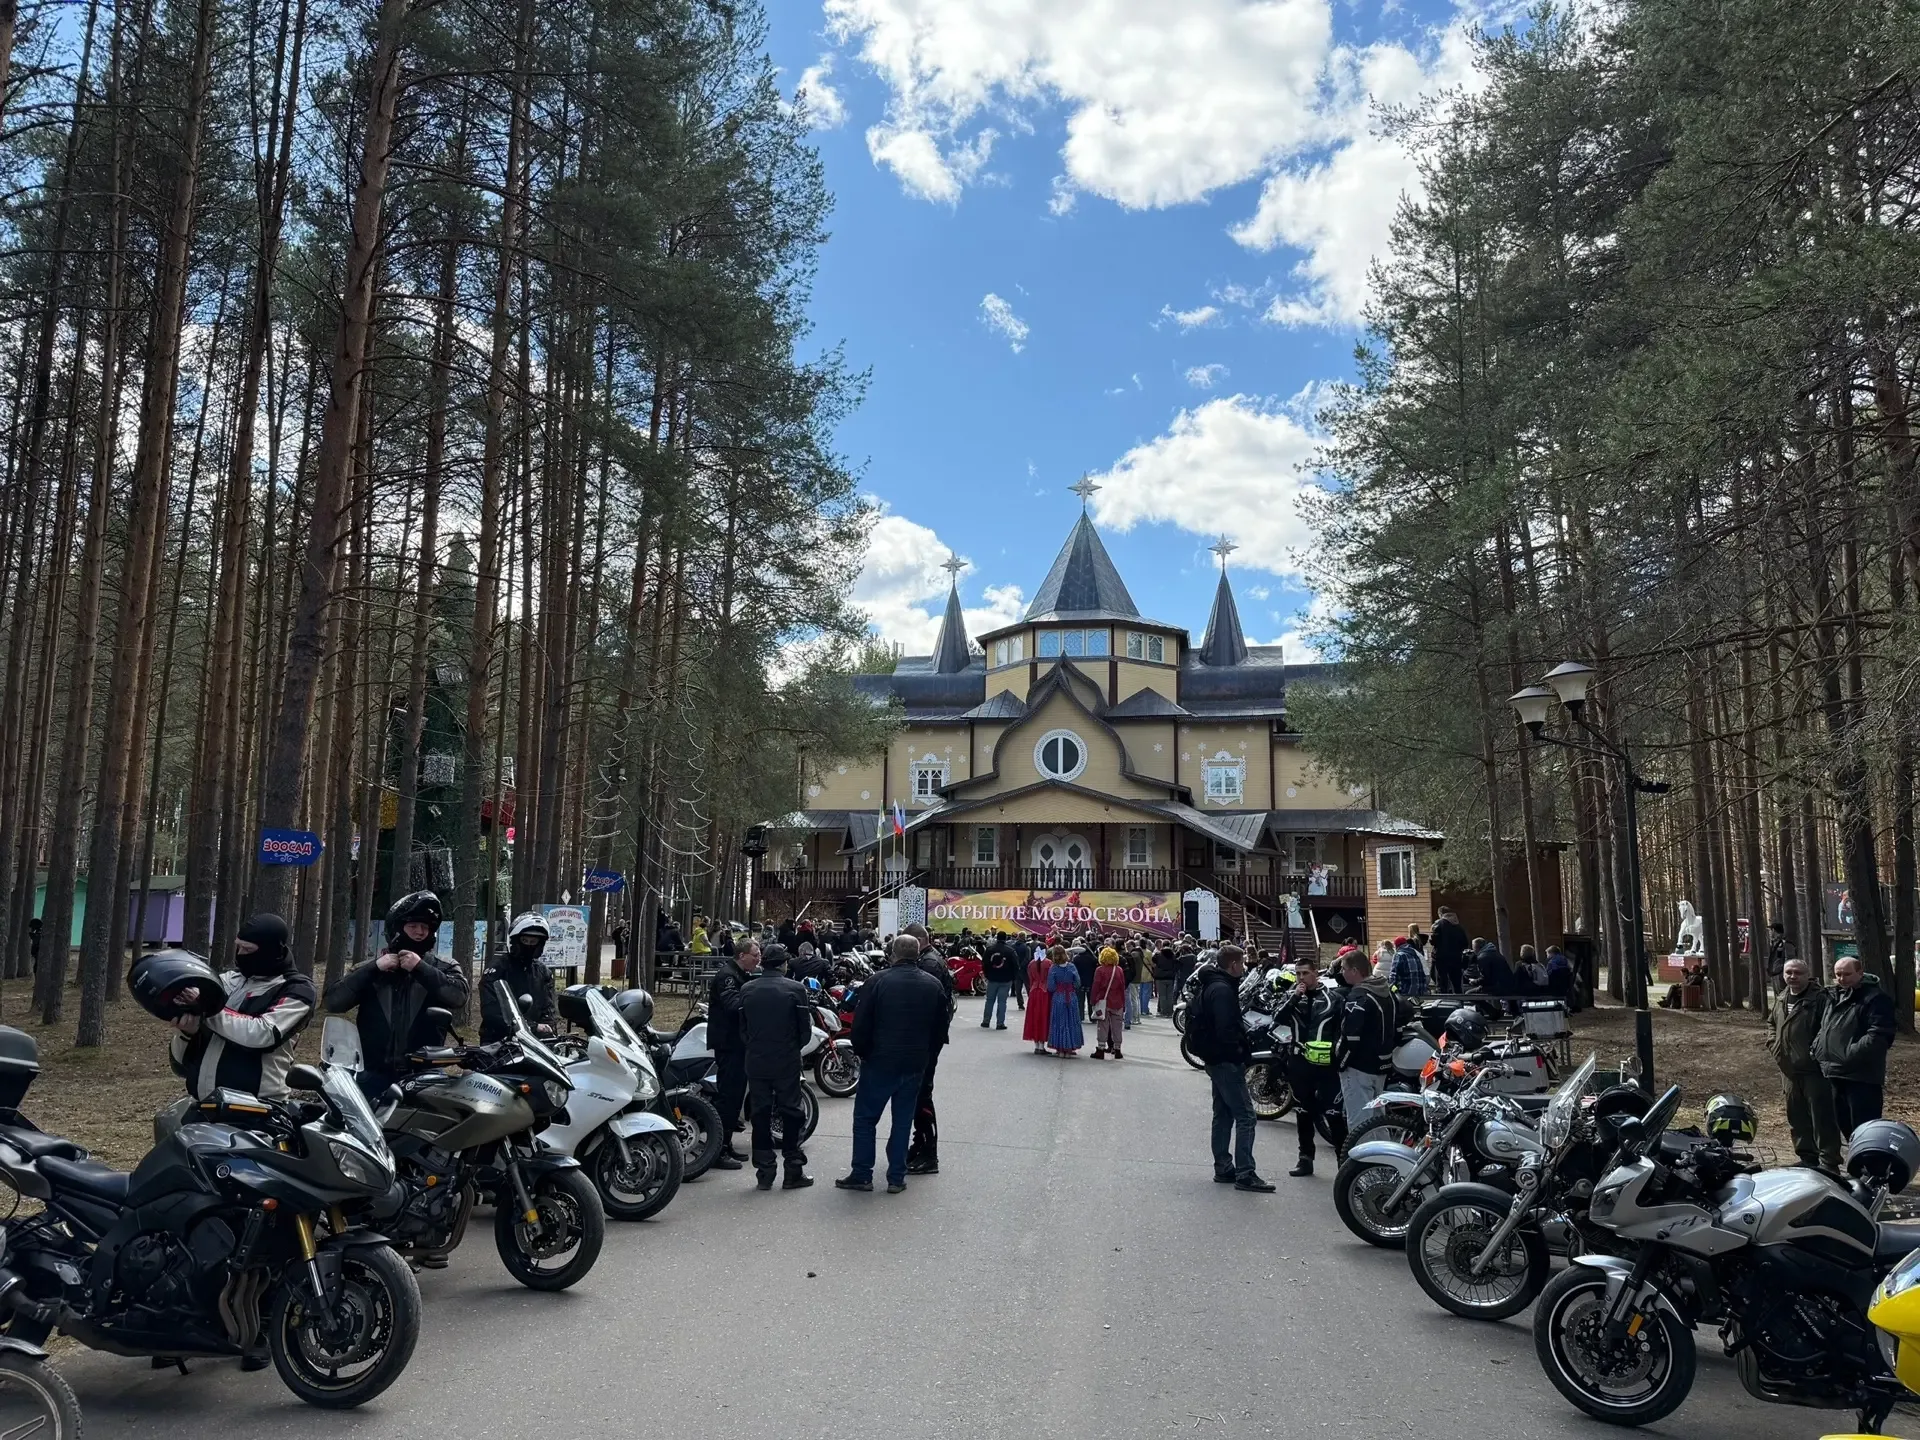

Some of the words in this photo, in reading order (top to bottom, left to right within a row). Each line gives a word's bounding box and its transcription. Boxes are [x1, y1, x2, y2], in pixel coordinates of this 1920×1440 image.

[263, 838, 311, 855] ЗООСАД
[934, 904, 1026, 920] ОКРЫТИЕ
[1032, 905, 1172, 923] МОТОСЕЗОНА
[473, 1080, 503, 1097] YAMAHA
